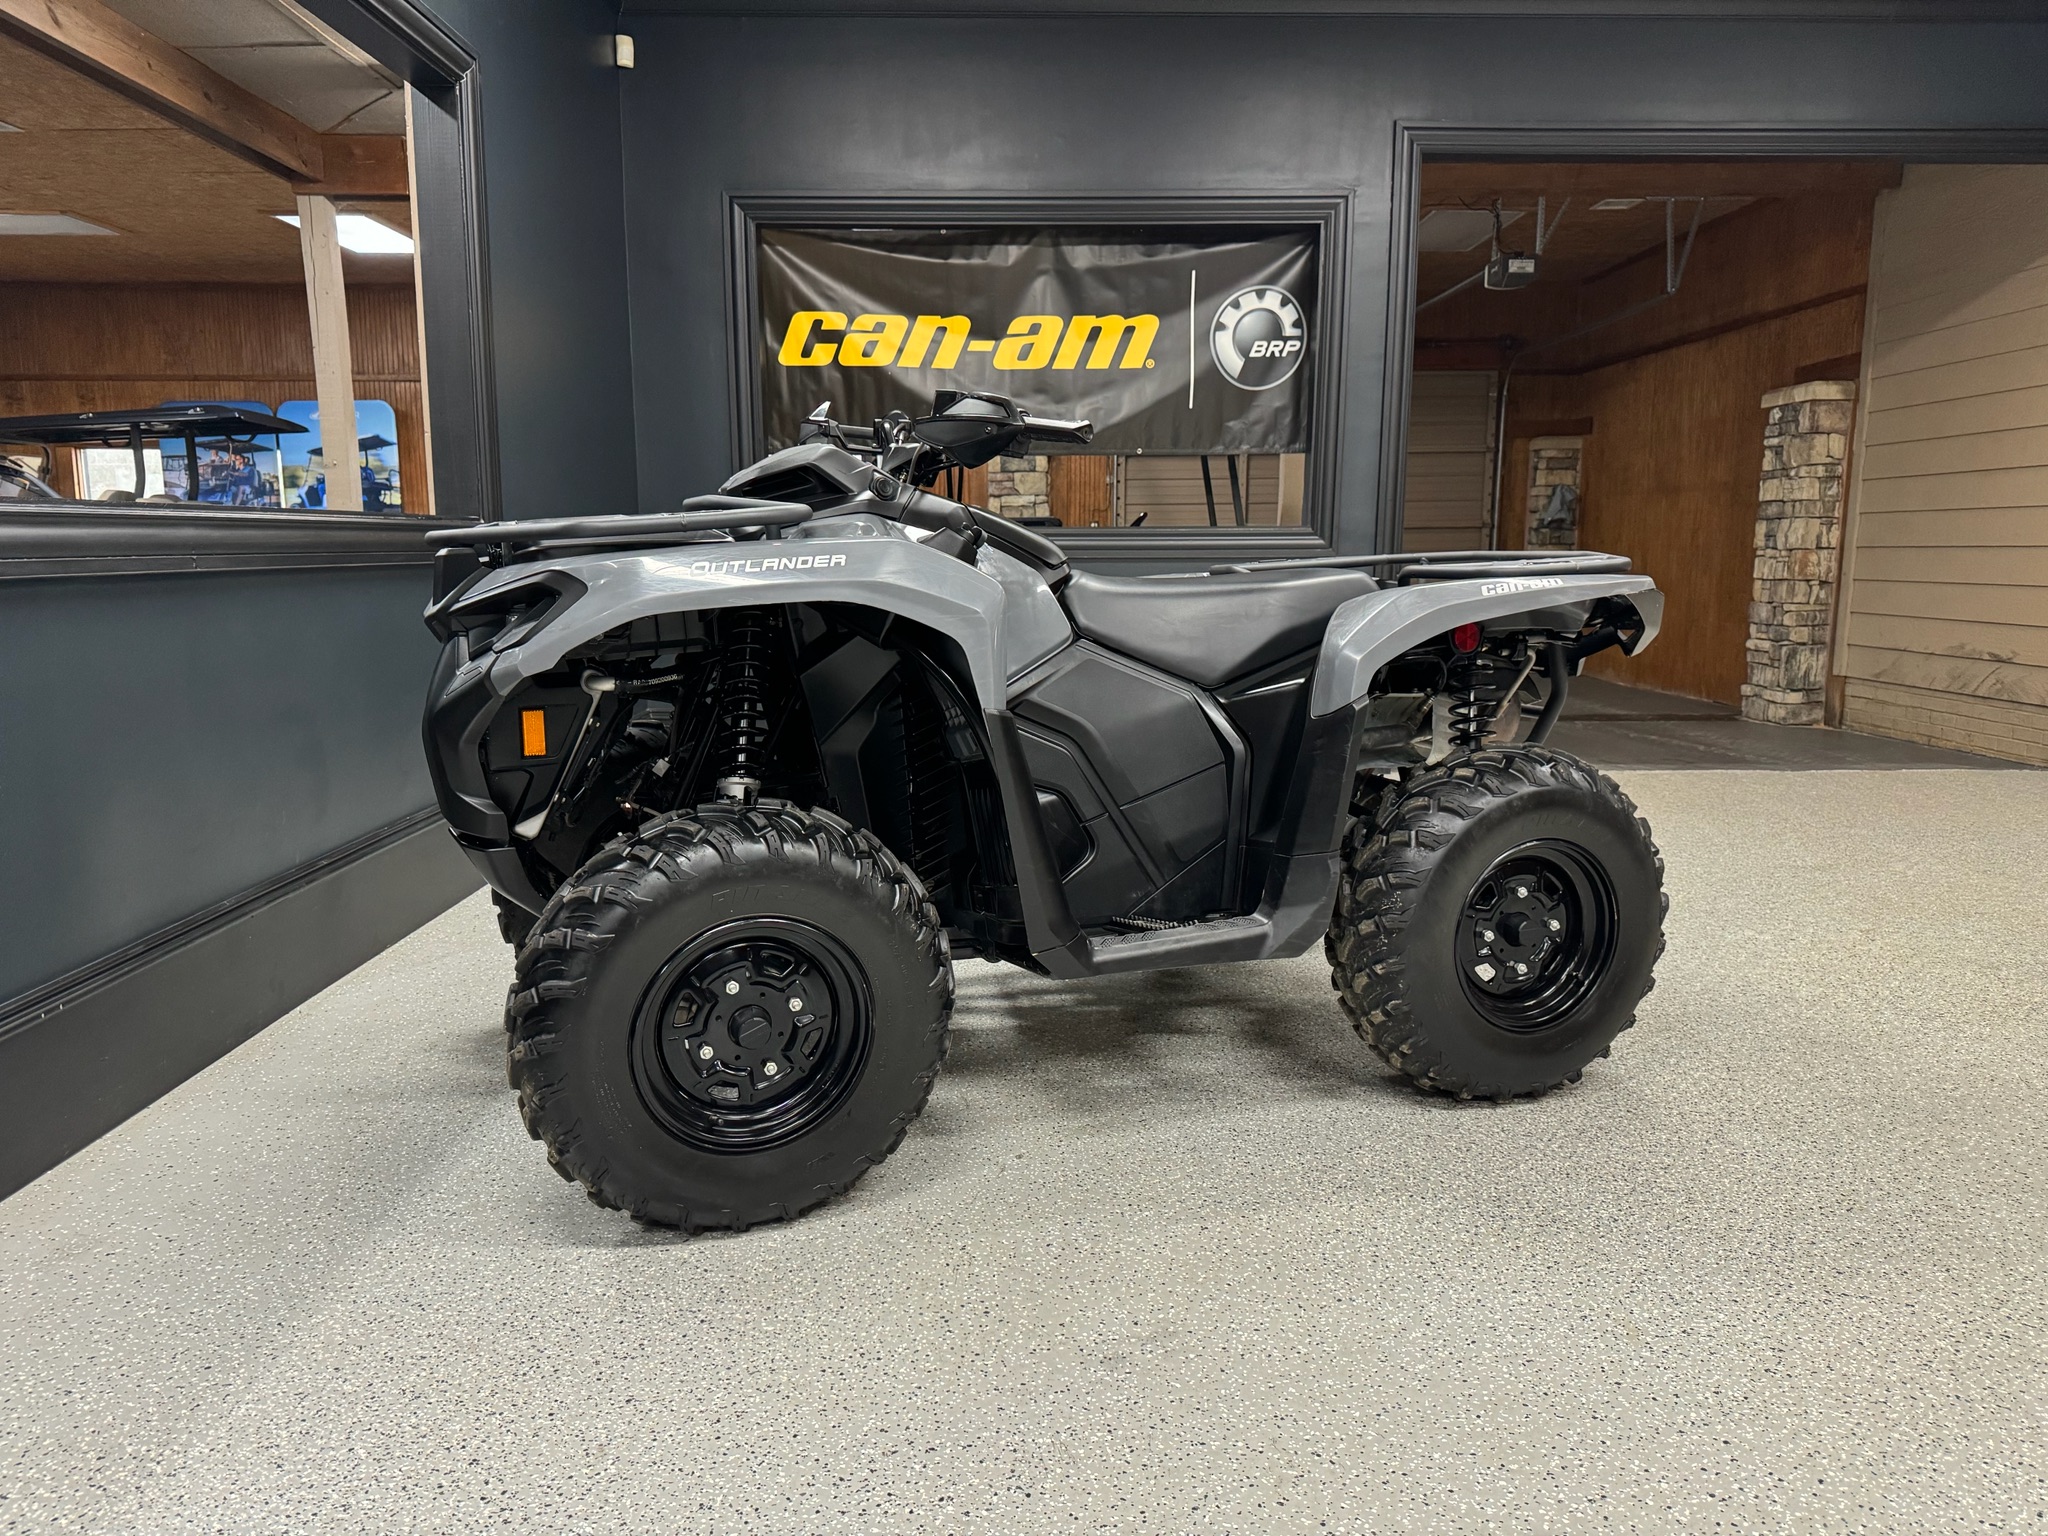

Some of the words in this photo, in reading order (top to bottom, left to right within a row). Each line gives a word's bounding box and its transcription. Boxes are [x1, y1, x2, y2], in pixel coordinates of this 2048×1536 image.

[777, 310, 1160, 370] can-am
[1248, 340, 1301, 358] BRP
[690, 554, 847, 577] OUTLANDER
[1480, 577, 1564, 596] can-am
